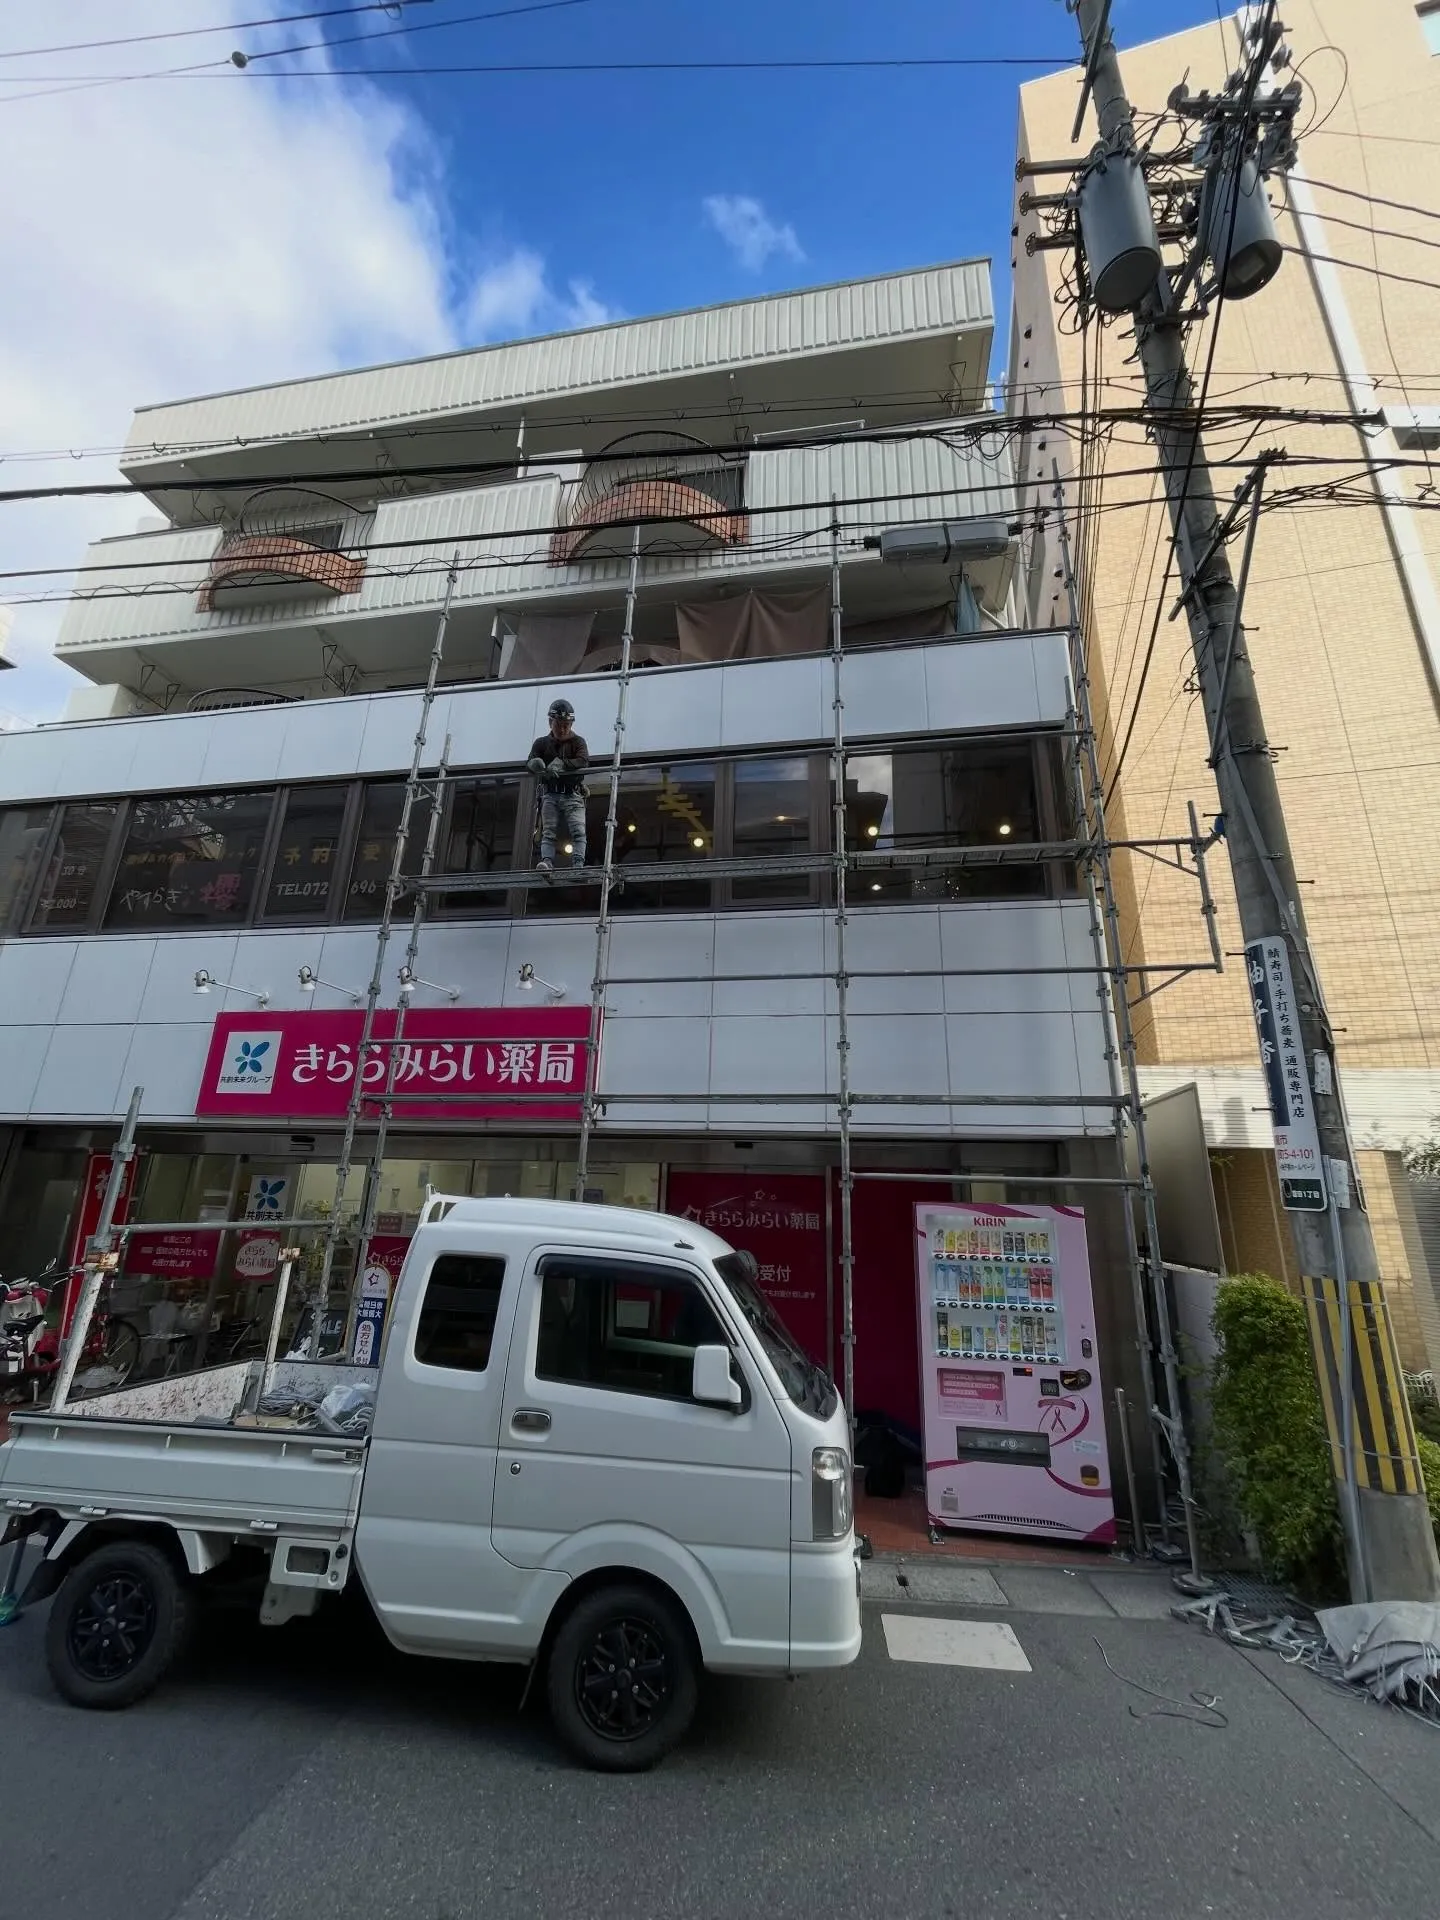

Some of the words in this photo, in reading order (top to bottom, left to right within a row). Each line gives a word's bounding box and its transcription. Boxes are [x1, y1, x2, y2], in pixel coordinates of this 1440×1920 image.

[292, 1043, 575, 1084] きららみらい薬局
[1285, 1055, 1305, 1118] 通販専門店
[704, 1210, 821, 1231] きららみらい薬局
[972, 1216, 1007, 1227] KIRIN
